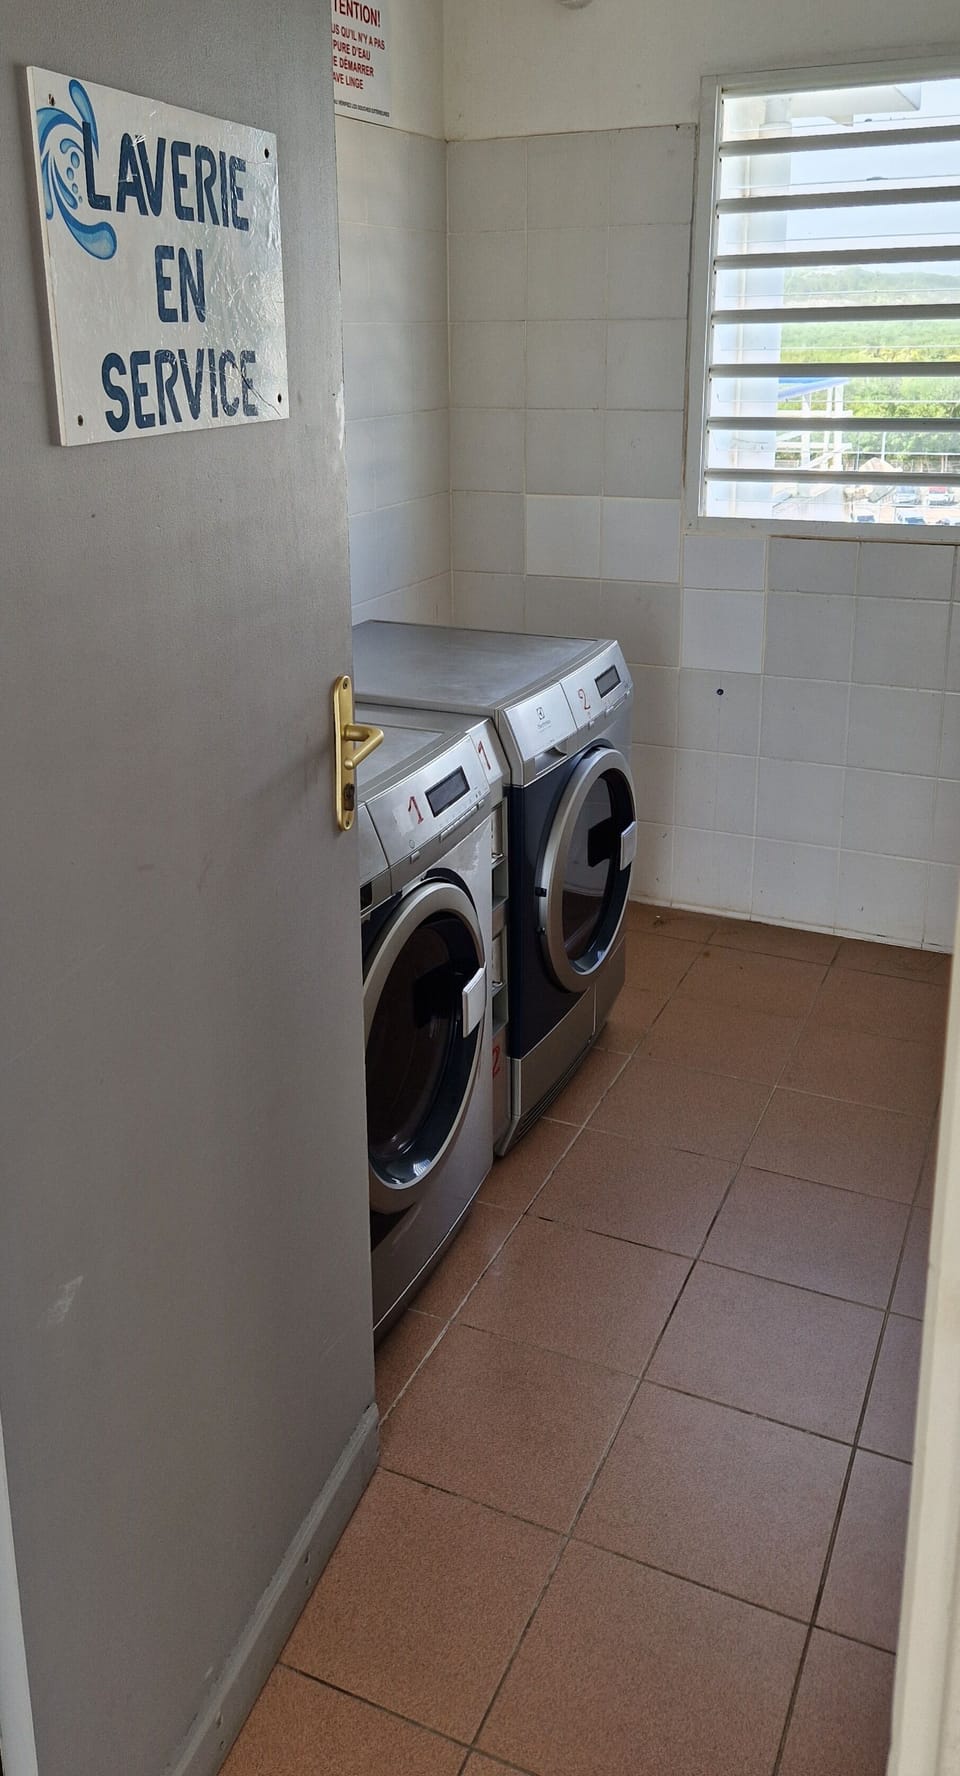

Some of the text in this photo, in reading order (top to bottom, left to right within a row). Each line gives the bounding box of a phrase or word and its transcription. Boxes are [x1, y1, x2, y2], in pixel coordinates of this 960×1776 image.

[333, 39, 371, 61] PURE D'EAU
[374, 38, 385, 50] PAS
[339, 56, 374, 77] DÉMARRER
[345, 75, 364, 90] LINGE
[82, 122, 250, 232] LAVERIE
[155, 245, 206, 323] EN
[101, 348, 259, 433] SERVICE
[577, 688, 591, 710] 2
[478, 741, 491, 770] 1
[408, 796, 424, 824] 1
